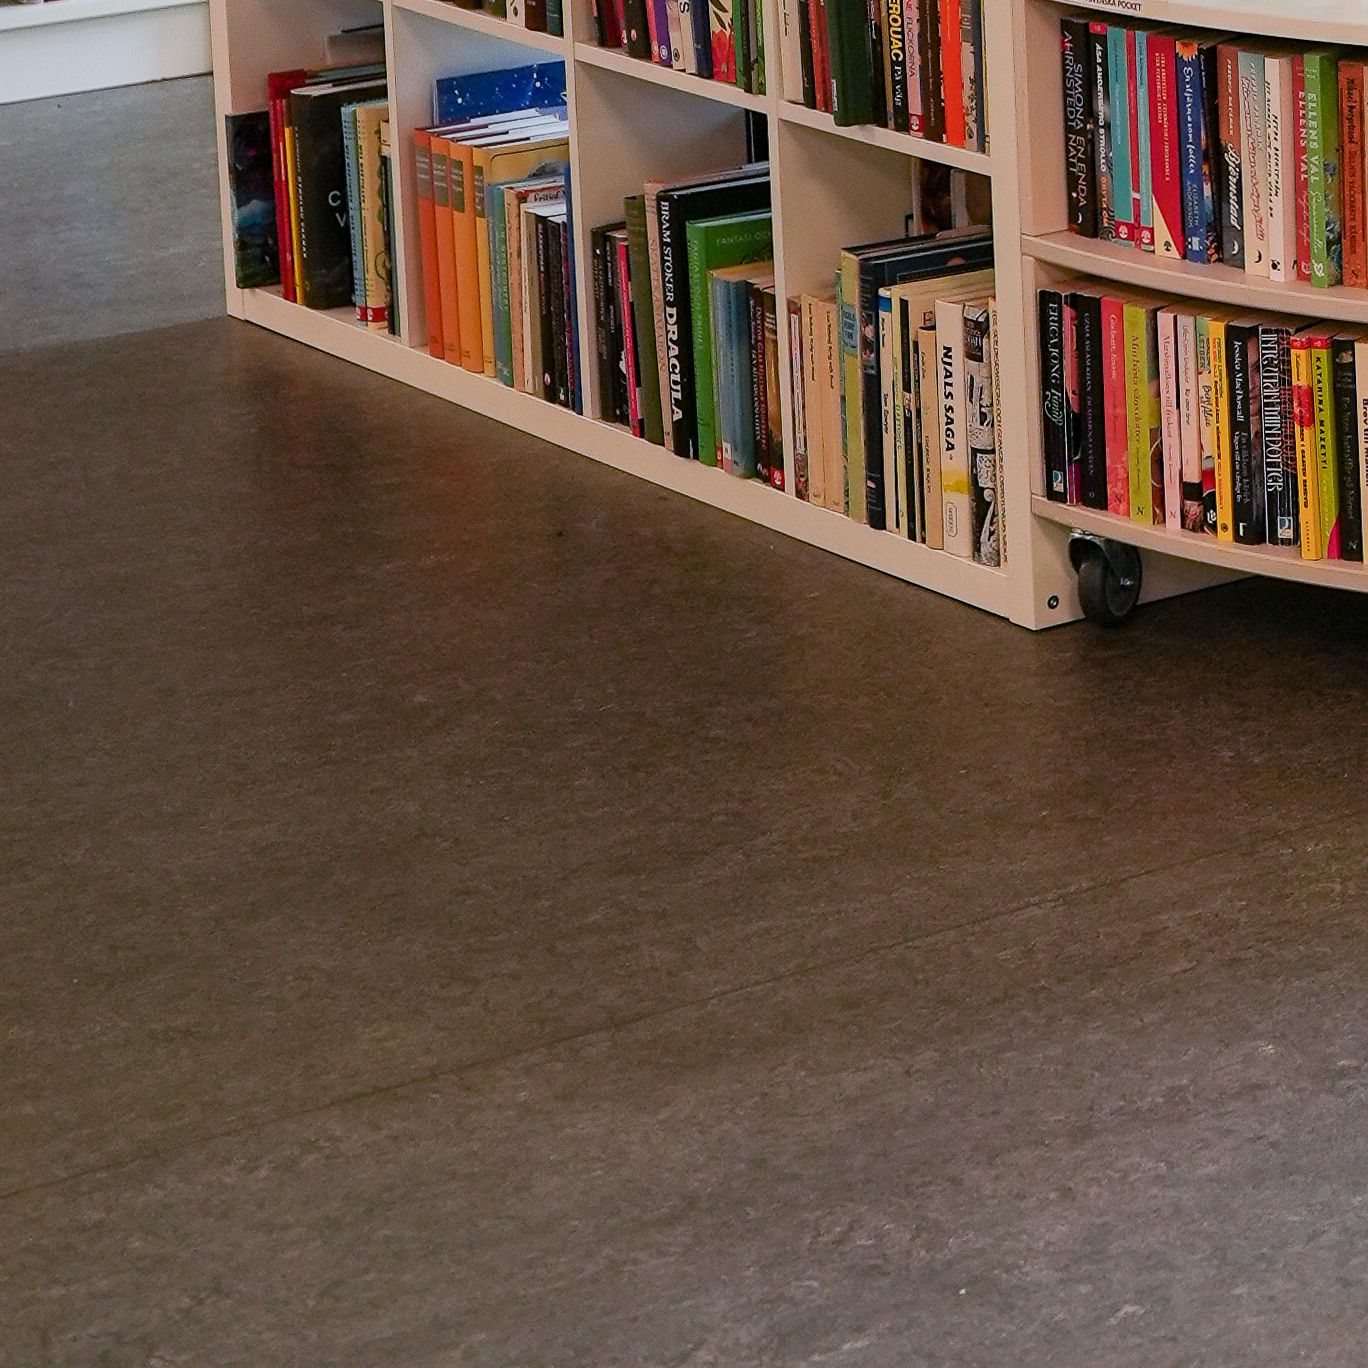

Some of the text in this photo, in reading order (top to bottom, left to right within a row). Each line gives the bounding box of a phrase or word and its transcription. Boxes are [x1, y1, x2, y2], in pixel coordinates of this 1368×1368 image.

[906, 18, 917, 79] FLICKORNA
[1064, 31, 1077, 174] AHRNSTEDT NATT
[1307, 93, 1319, 149] ELLENS
[1224, 143, 1241, 230] Björnstad
[1309, 155, 1319, 183] VAL
[660, 201, 683, 422] BRAM STOKER DRACULA
[1047, 303, 1062, 384] ERICA JONG
[942, 345, 955, 452] NJALS SAGA
